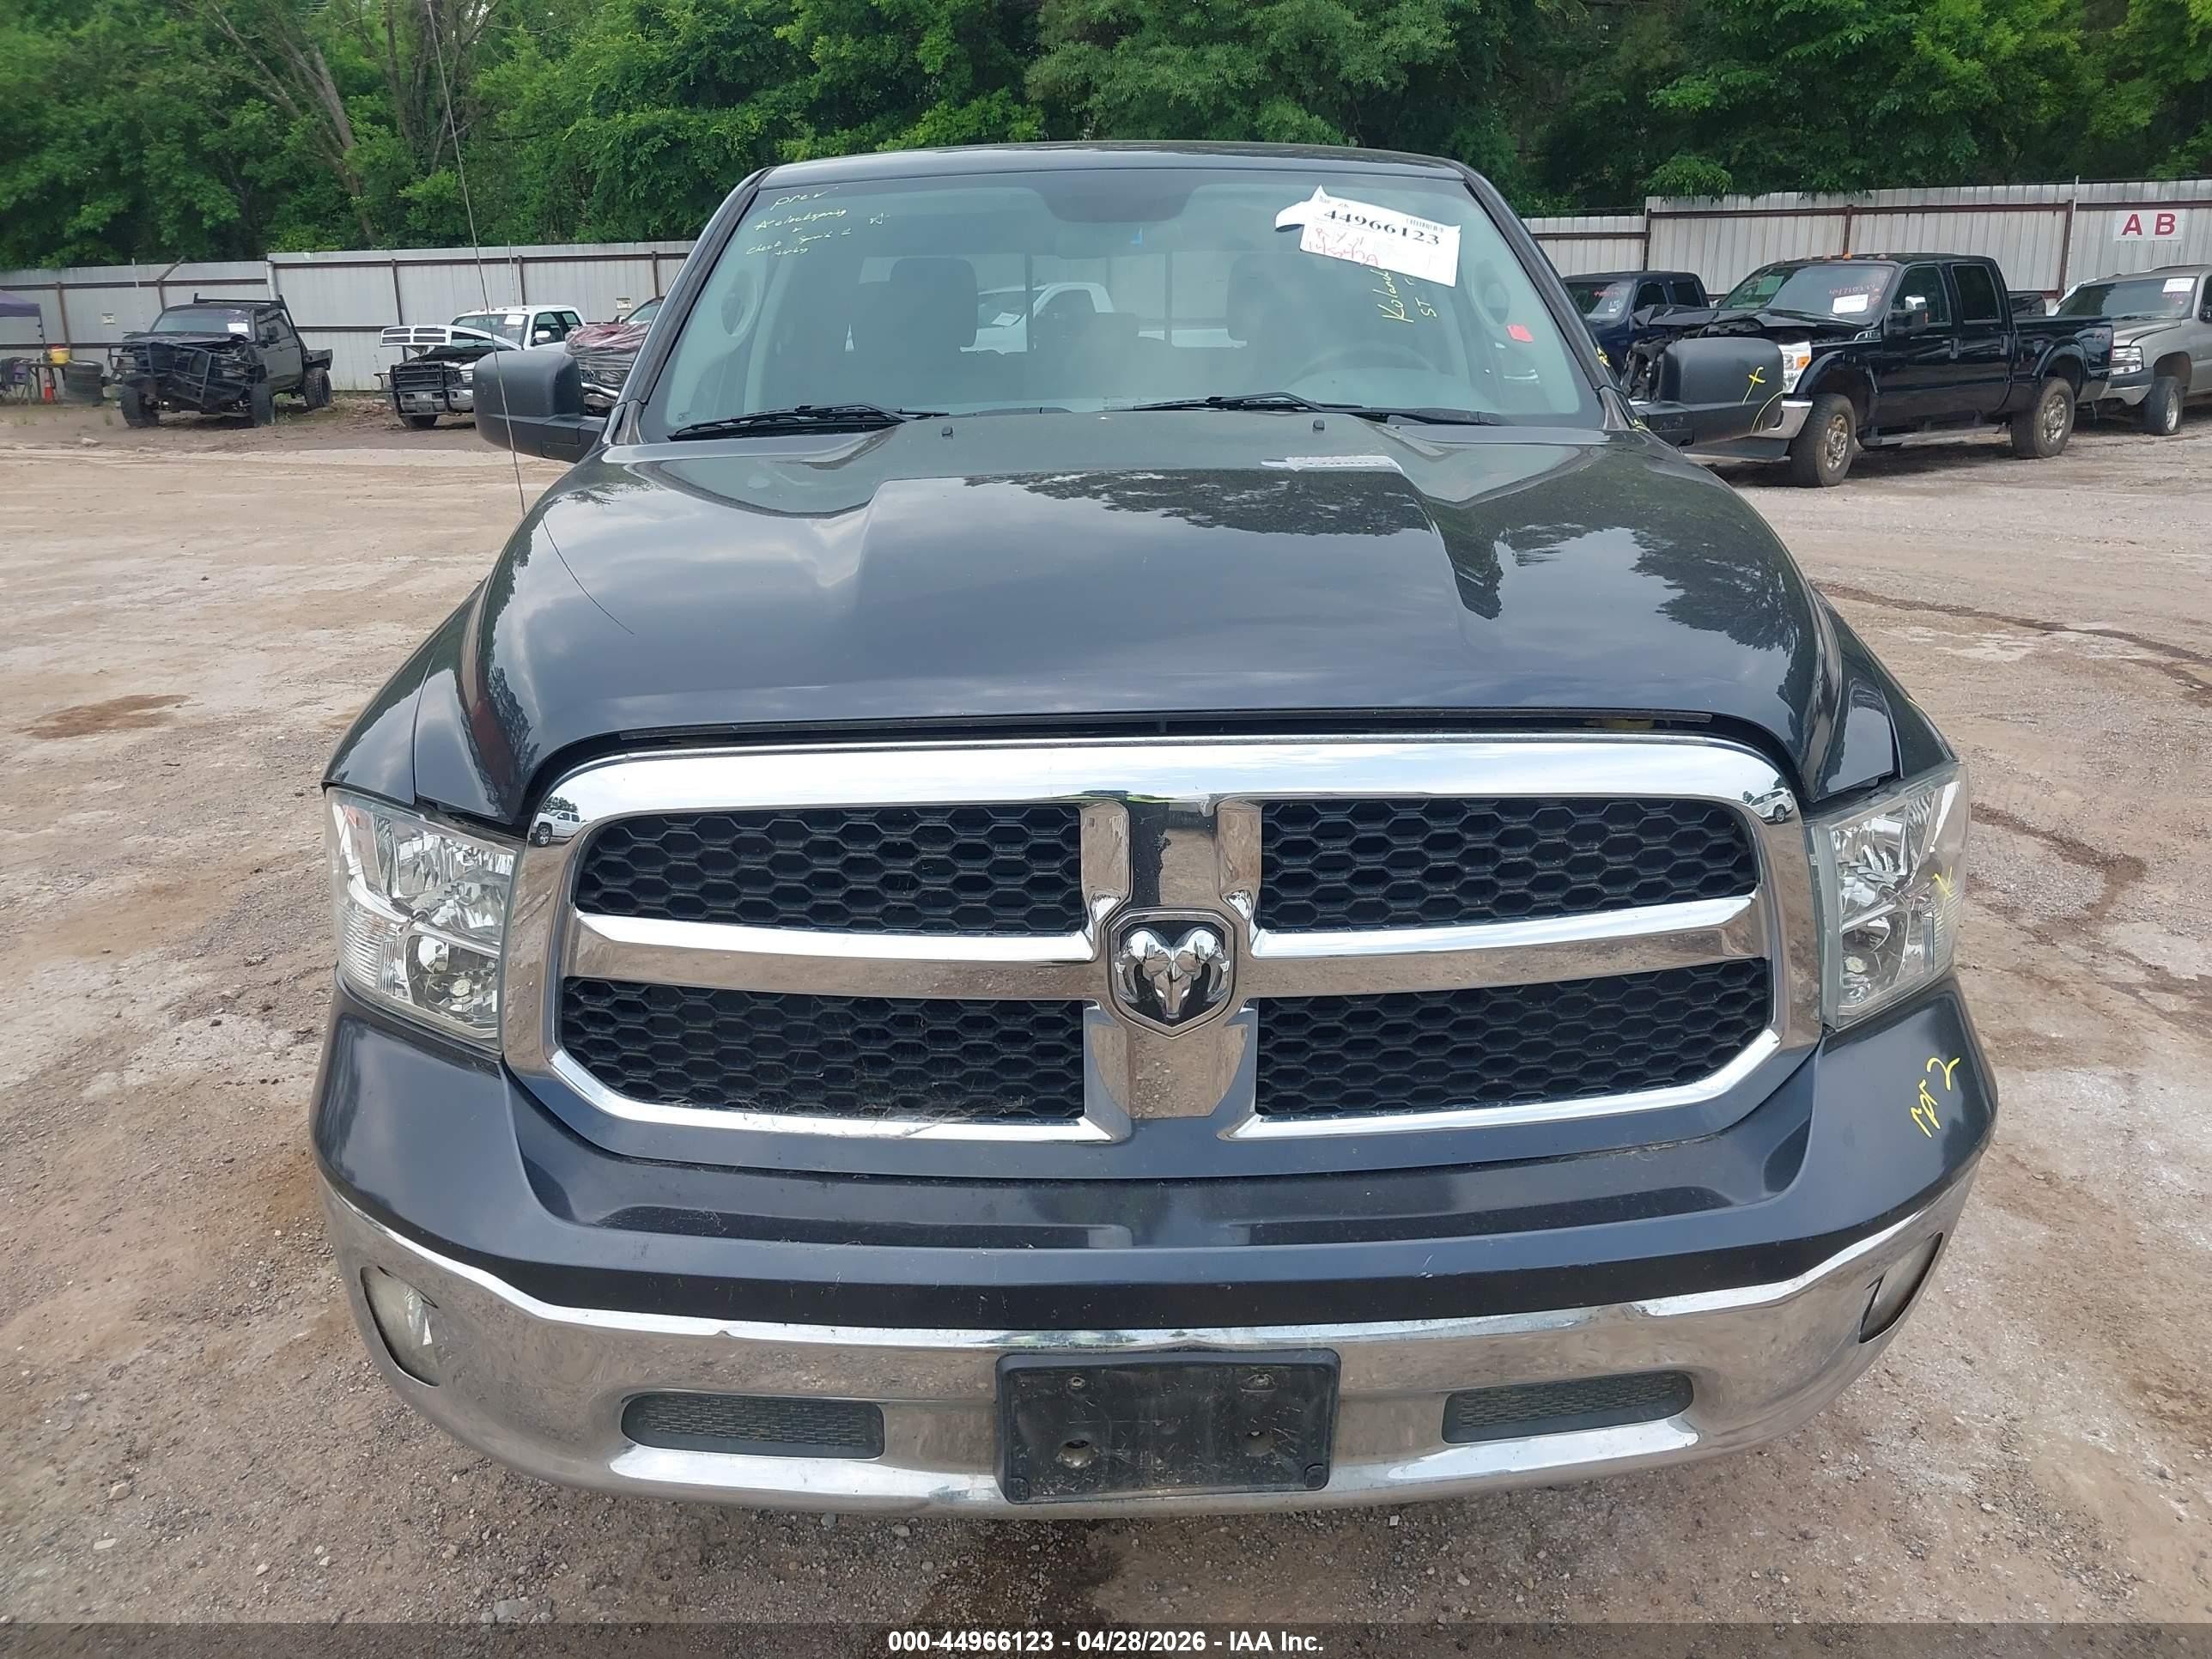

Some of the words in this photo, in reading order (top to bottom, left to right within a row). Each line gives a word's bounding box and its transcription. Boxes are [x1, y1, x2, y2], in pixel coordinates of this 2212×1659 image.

[1323, 209, 1440, 246] 44966123
[2121, 213, 2143, 236] A
[2154, 212, 2177, 236] B
